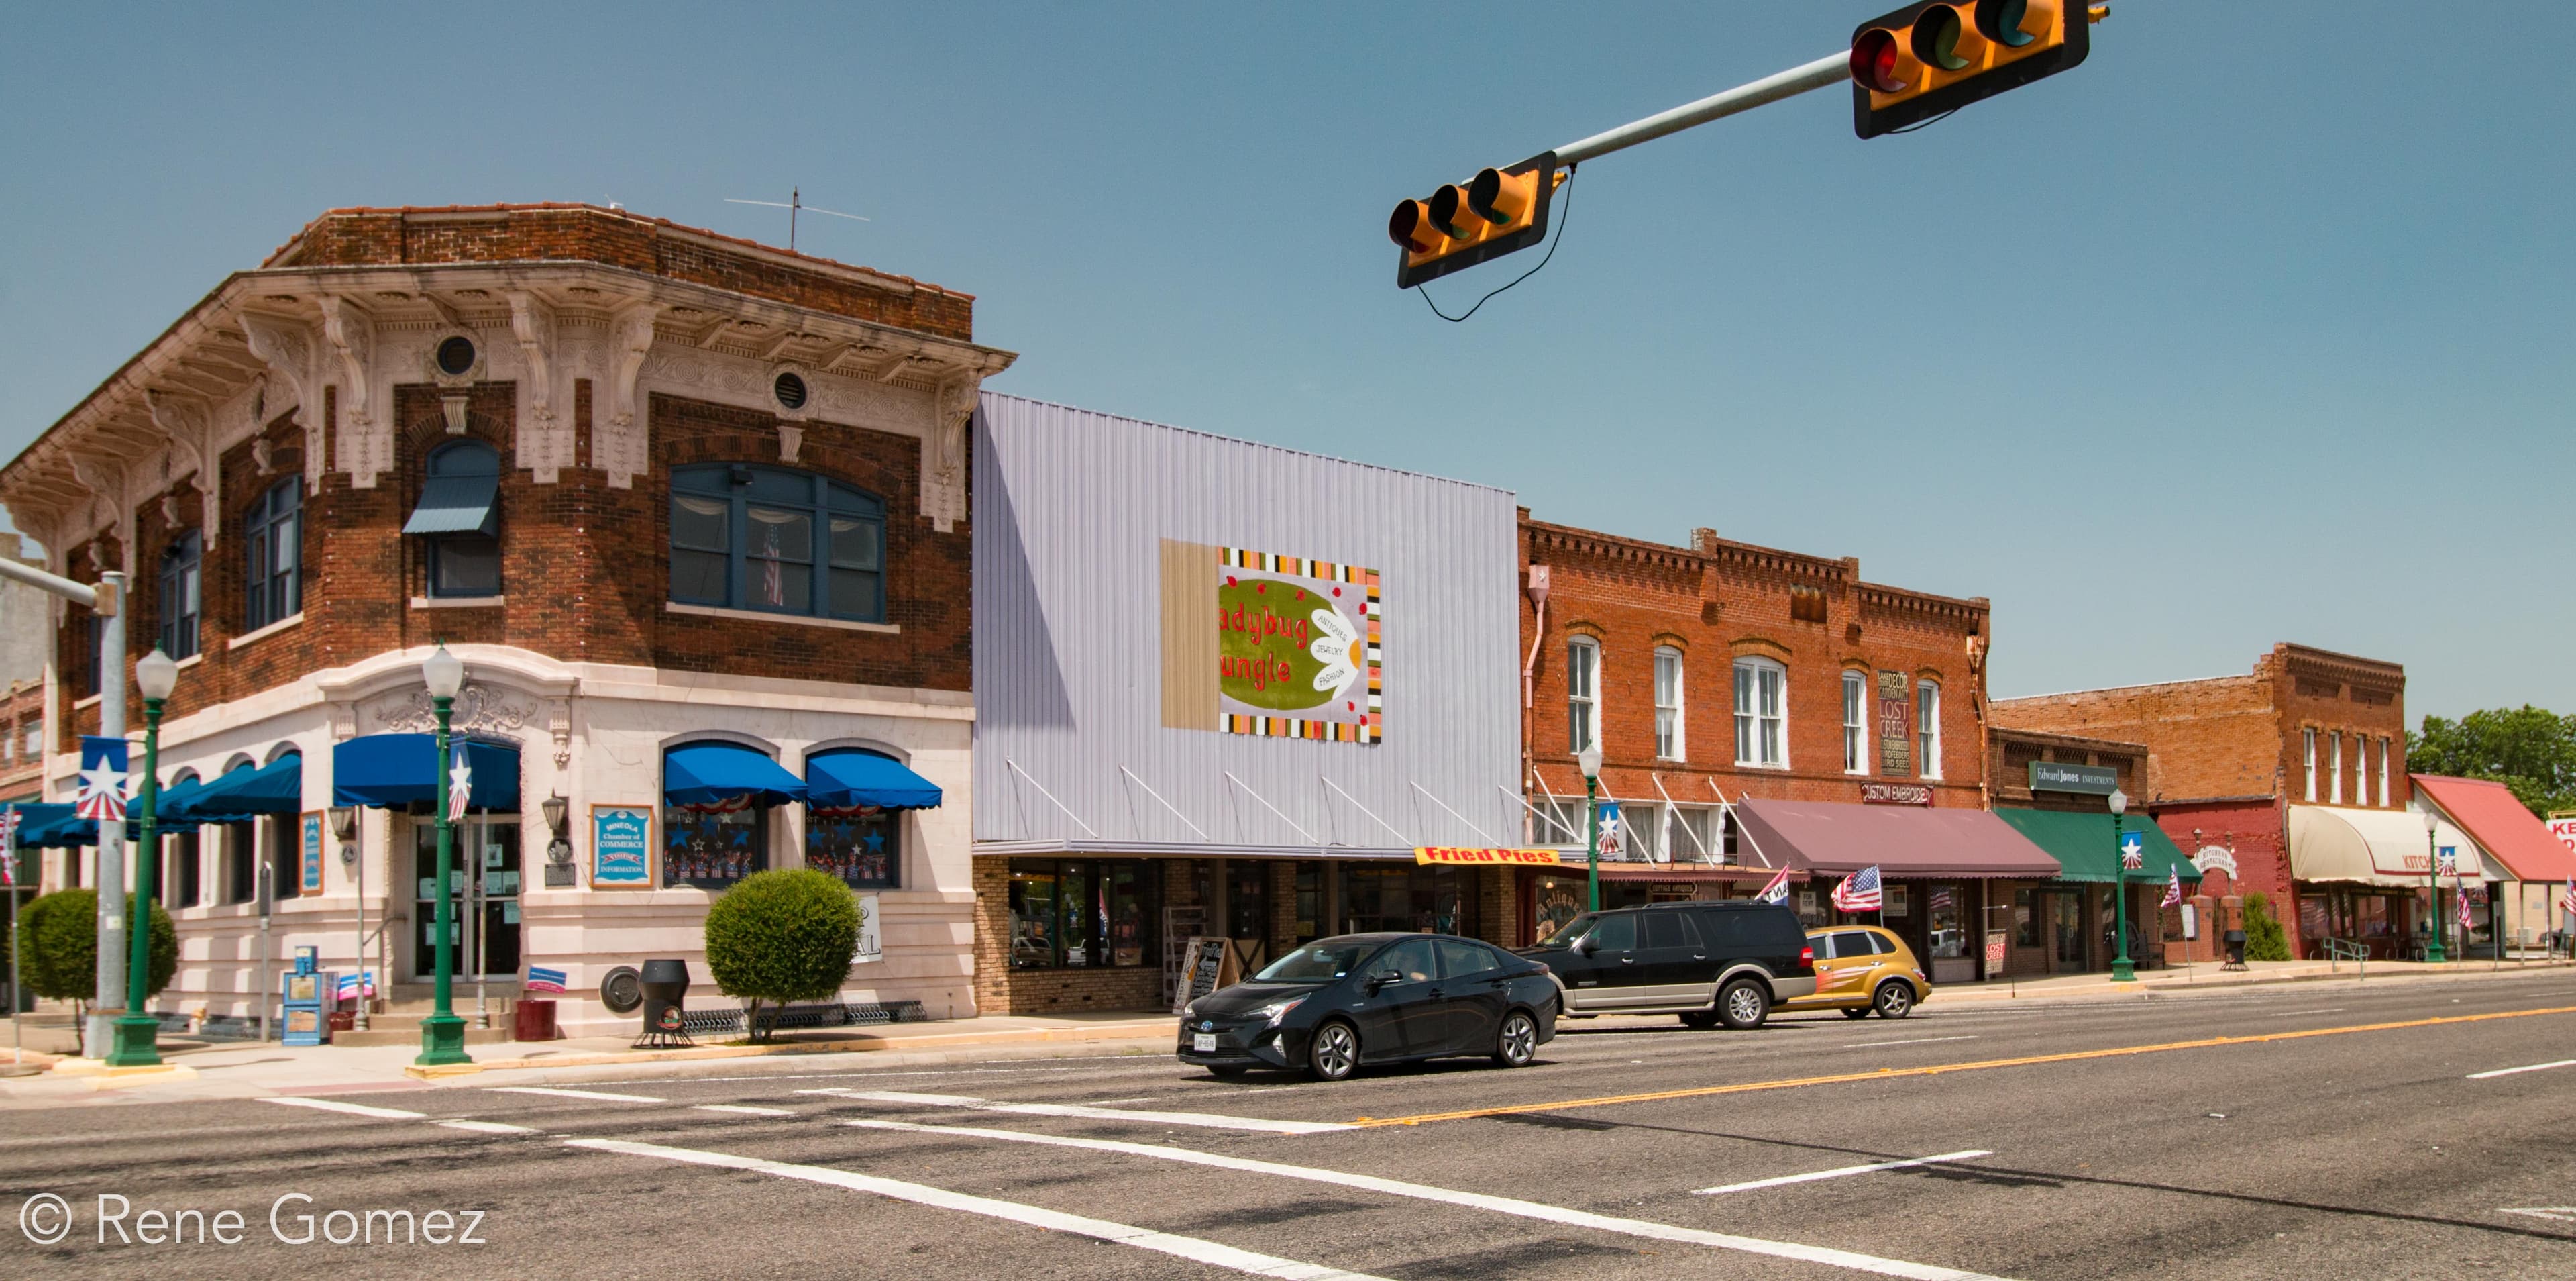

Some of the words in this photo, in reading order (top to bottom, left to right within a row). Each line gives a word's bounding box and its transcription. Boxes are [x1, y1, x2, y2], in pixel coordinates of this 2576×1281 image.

[1318, 615, 1347, 642] ANTIQUES
[1316, 644, 1343, 656] JEWELRY
[1319, 667, 1344, 686] FASHION
[1888, 673, 1908, 689] DECOR
[1898, 689, 1909, 699] ART
[1879, 701, 1908, 720] LOST
[1880, 719, 1908, 738] CREEK
[1895, 759, 1910, 768] SEED
[2037, 767, 2060, 781] Edward
[2060, 769, 2079, 783] Jones
[2082, 774, 2114, 785] INVESTMENTS
[1862, 784, 1890, 802] CUSTOM
[606, 823, 638, 832] MINEOLA
[1424, 847, 1493, 861] Fried
[1496, 849, 1553, 863] Pies
[1672, 884, 1693, 893] ANTIQUES
[1986, 943, 2004, 952] LOST
[1986, 952, 2004, 960] CREEK
